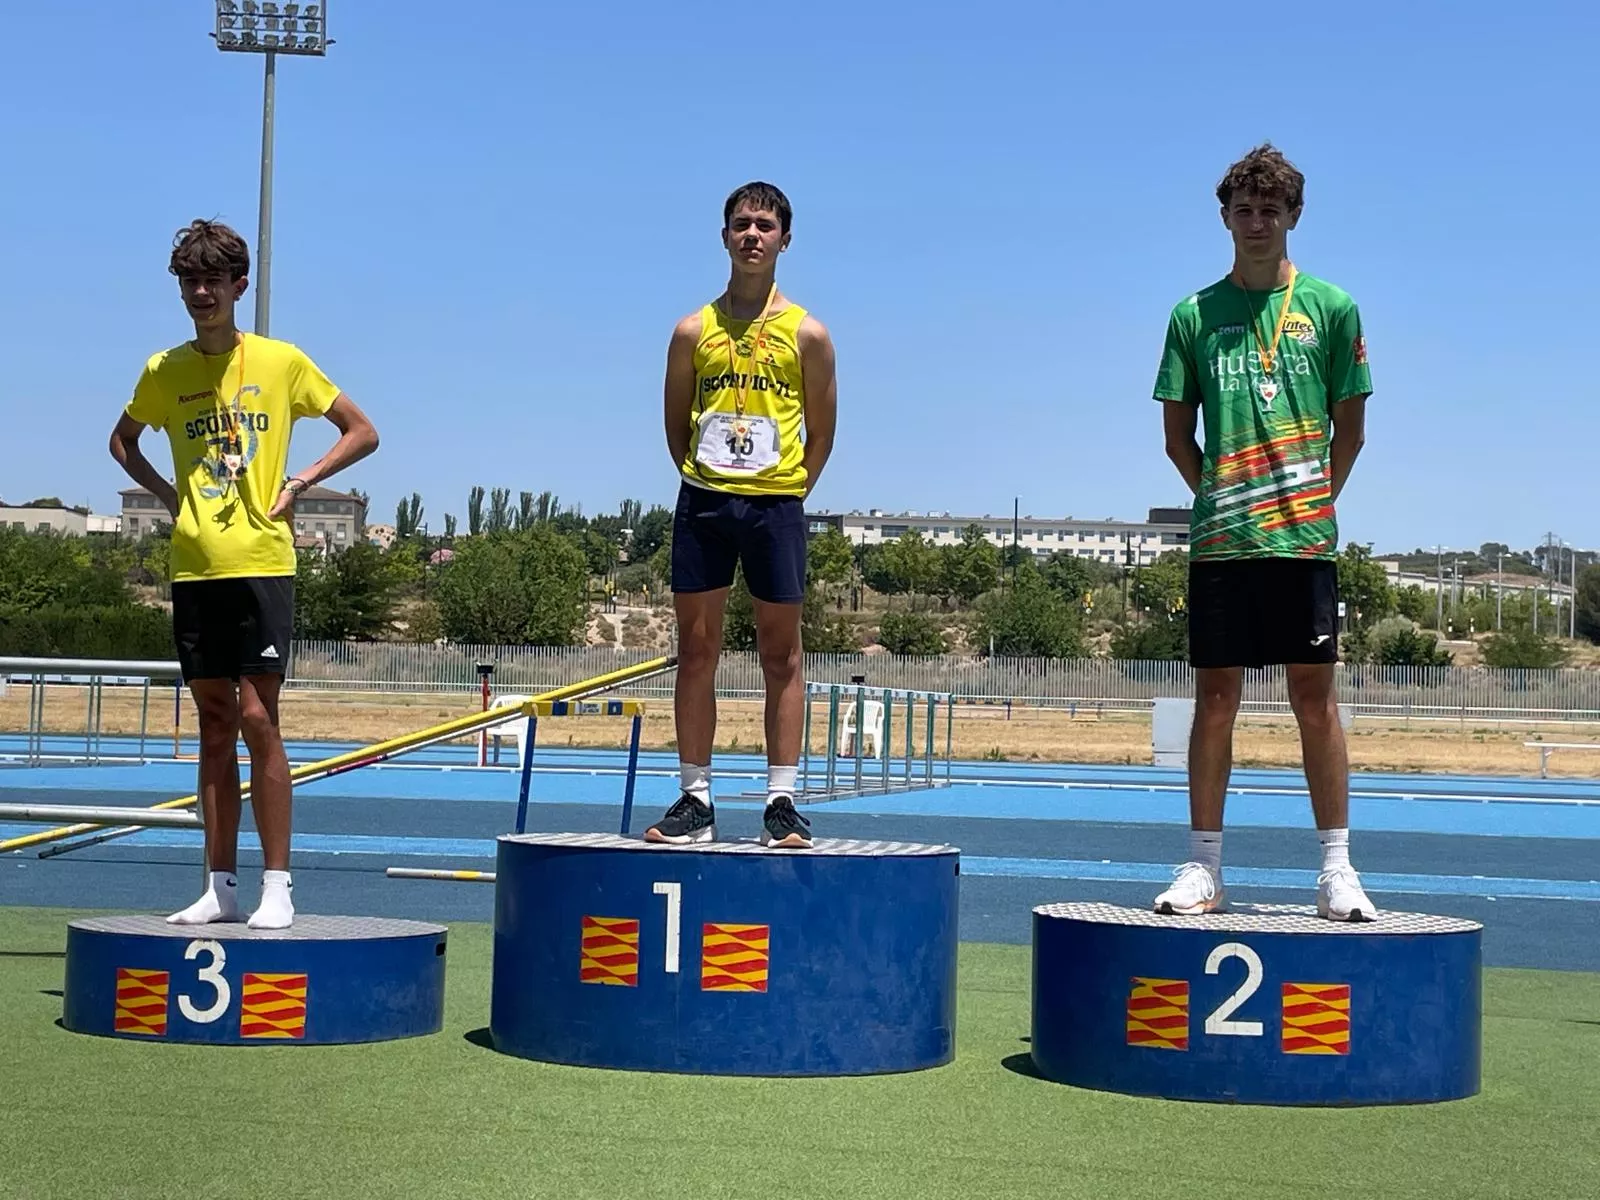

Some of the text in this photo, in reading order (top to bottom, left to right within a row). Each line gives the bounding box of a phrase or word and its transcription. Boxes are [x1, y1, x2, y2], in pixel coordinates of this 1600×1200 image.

[1219, 376, 1240, 392] La
[653, 882, 681, 973] 1
[178, 939, 231, 1023] 3
[1205, 942, 1263, 1036] 2
